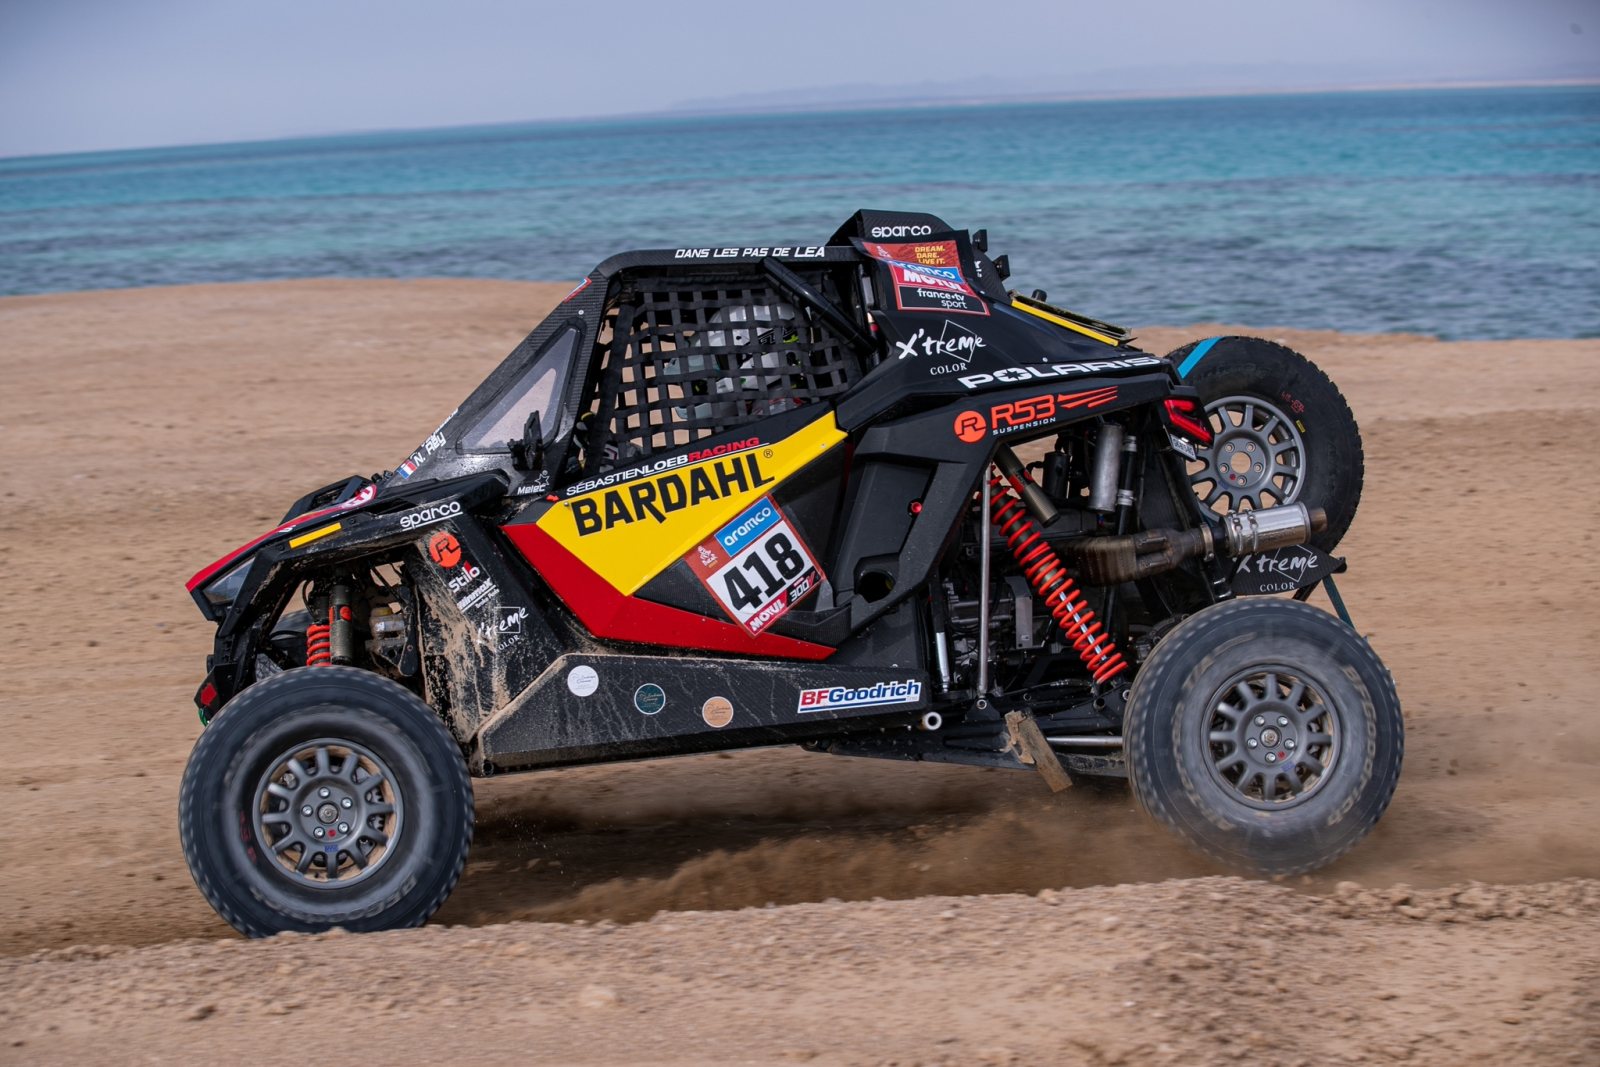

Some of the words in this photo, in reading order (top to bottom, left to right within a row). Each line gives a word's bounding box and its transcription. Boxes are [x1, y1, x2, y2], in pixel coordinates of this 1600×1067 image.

[872, 225, 931, 238] sparco
[674, 248, 711, 259] DANS
[713, 248, 739, 258] LES
[742, 247, 770, 257] PAS
[772, 247, 791, 257] DE
[794, 246, 825, 258] LEA
[914, 245, 945, 253] DREAM.
[941, 299, 968, 310] sport
[929, 362, 968, 376] COLOR
[957, 356, 1160, 389] POLARIS
[990, 393, 1056, 429] R53
[992, 416, 1057, 436] SUSPENSION
[413, 451, 426, 467] N.
[570, 451, 776, 538] BARDAHL
[399, 501, 462, 529] sparco
[724, 506, 772, 547] aramco
[723, 532, 805, 612] 418
[1259, 581, 1296, 593] COLOR
[749, 598, 786, 632] MOTUL
[497, 633, 521, 652] OLOR
[801, 681, 920, 706] BFGoodrich
